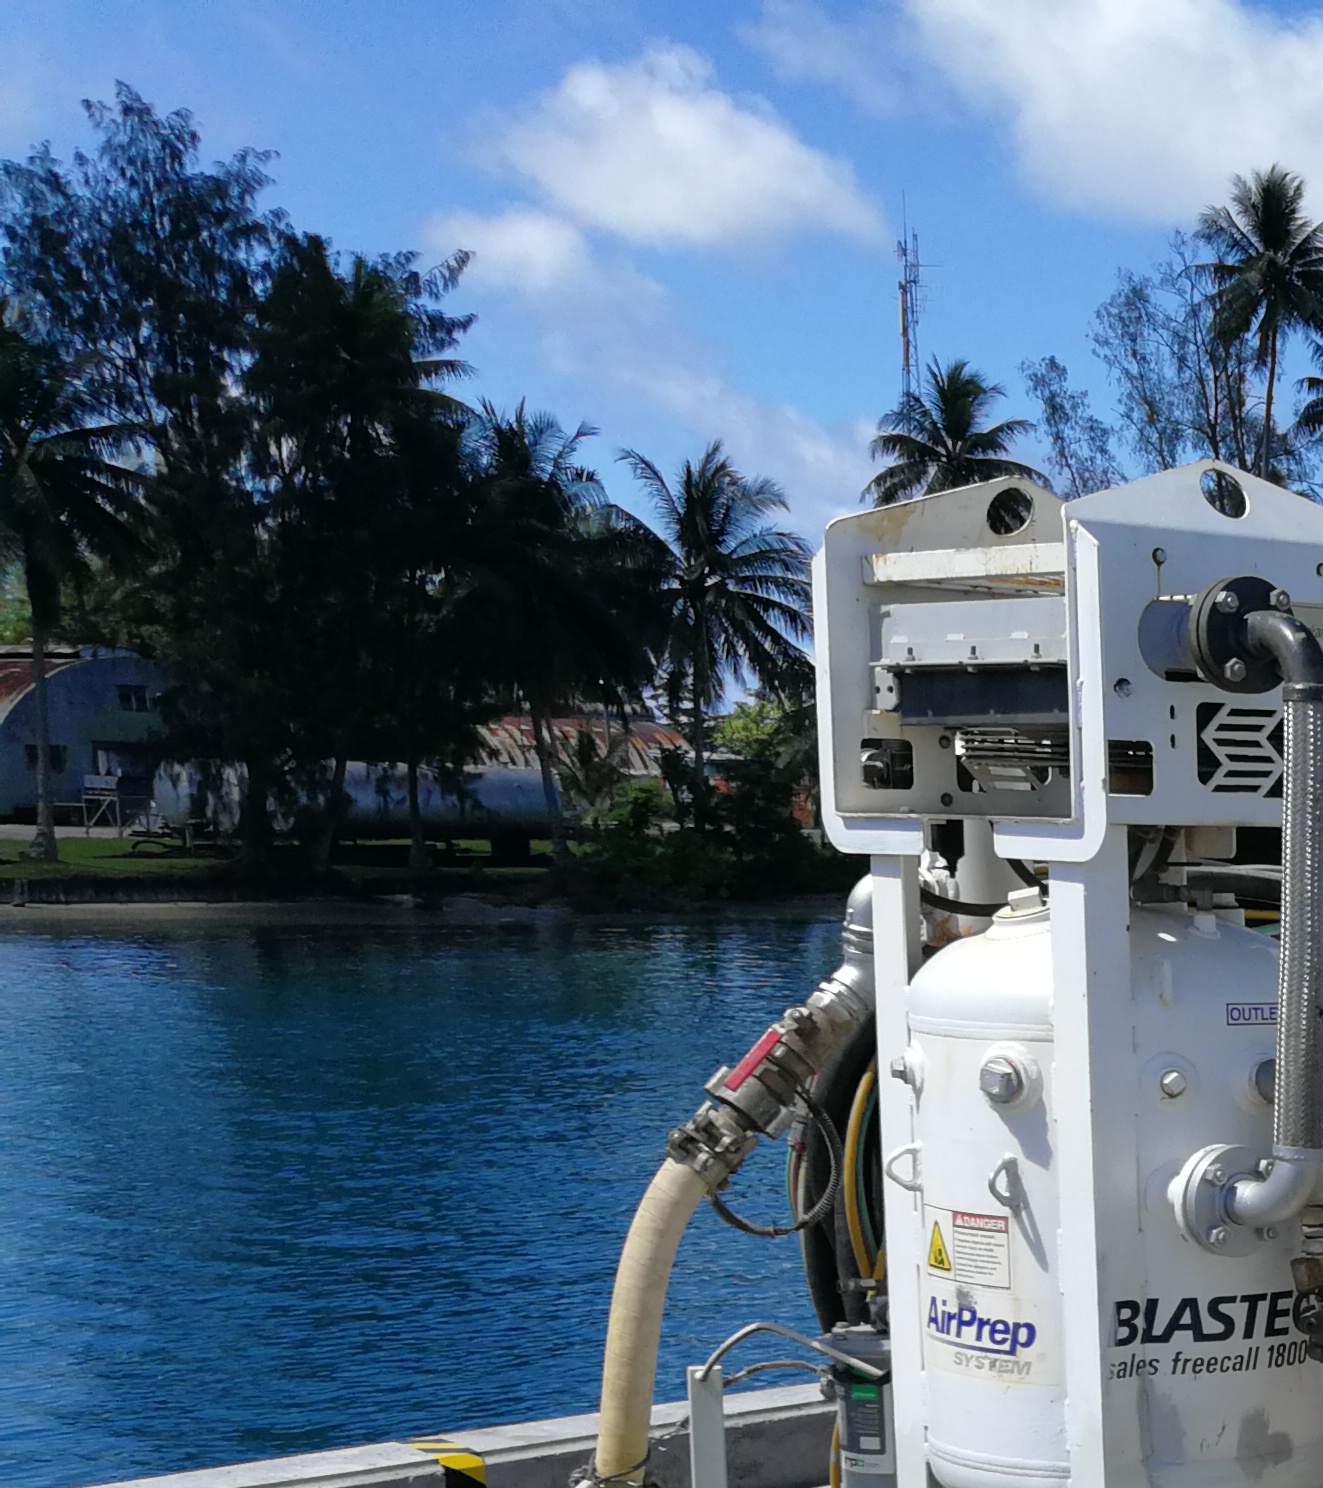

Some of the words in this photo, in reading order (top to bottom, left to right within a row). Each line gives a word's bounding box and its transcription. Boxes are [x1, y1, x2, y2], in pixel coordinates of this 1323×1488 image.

[1230, 1007, 1278, 1021] OUTLE
[964, 1214, 1006, 1231] DANGER
[927, 1296, 1037, 1357] AirPrep
[953, 1351, 1032, 1376] SYSTEM
[1171, 1346, 1260, 1376] freecall
[1267, 1339, 1308, 1369] 1800
